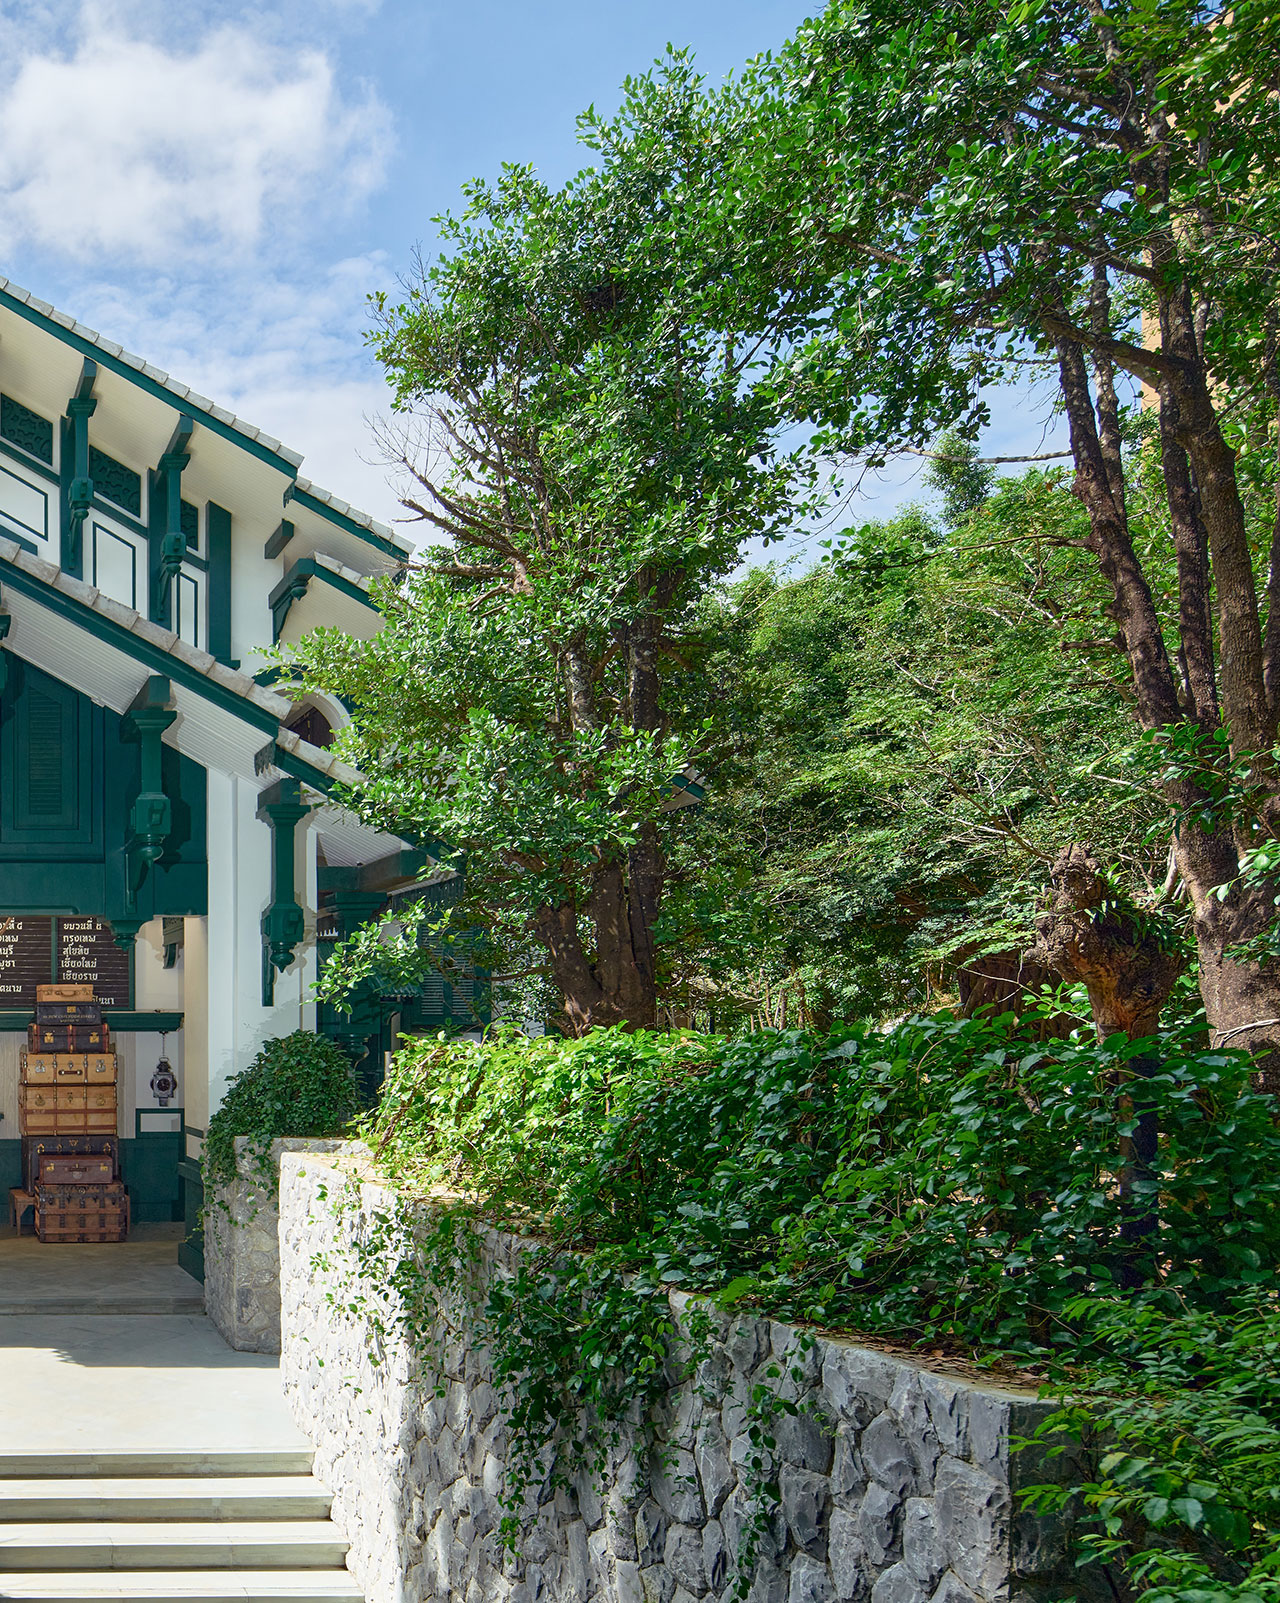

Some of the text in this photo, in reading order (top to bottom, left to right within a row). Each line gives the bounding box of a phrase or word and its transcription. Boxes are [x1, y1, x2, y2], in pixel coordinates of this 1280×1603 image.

[63, 917, 93, 930] ขบวนที่
[61, 956, 97, 968] เชียงใหม่
[62, 970, 98, 981] เชียงราย
